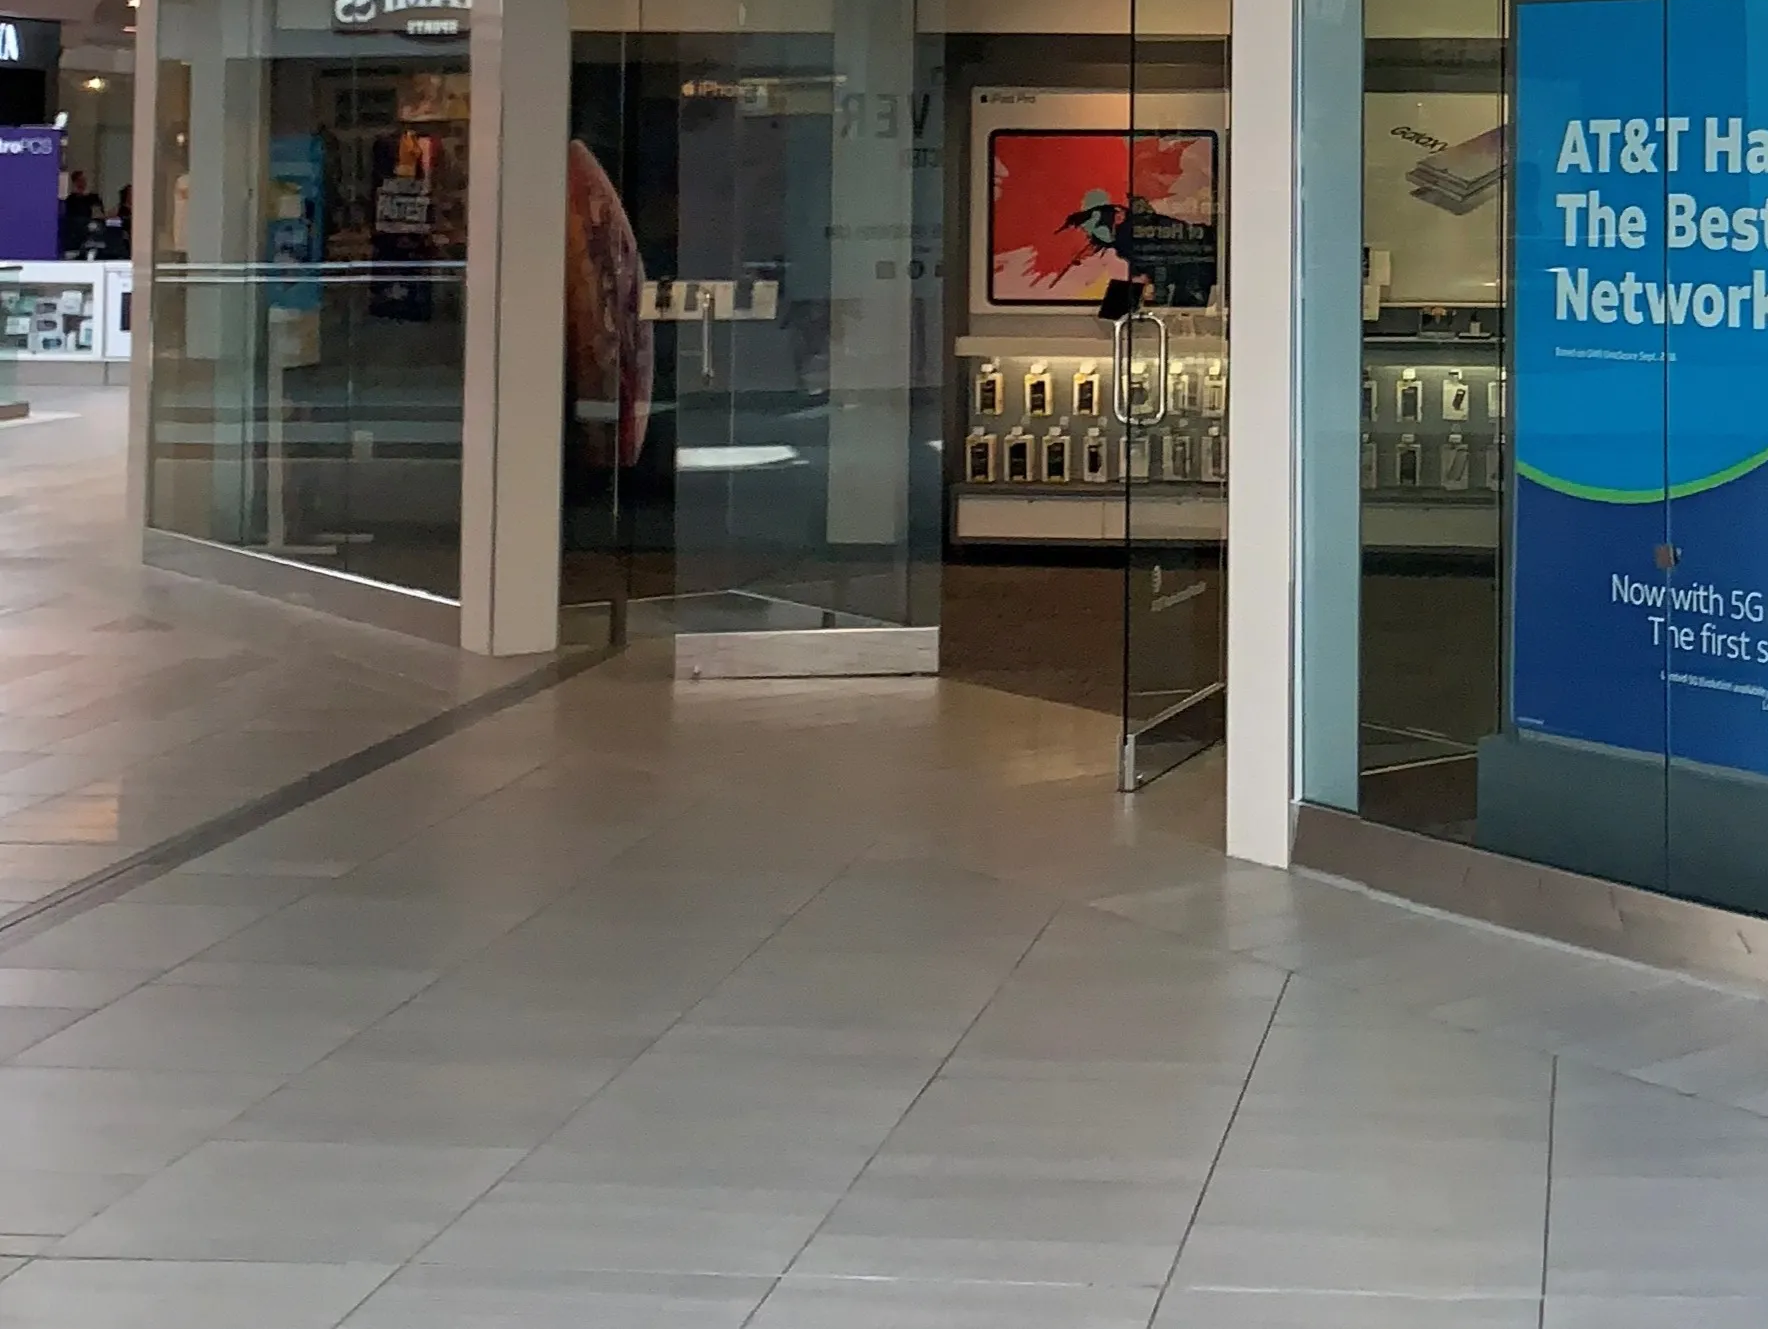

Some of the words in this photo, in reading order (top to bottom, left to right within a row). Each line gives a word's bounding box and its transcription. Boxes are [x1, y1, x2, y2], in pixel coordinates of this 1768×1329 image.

[1390, 126, 1449, 153] Galaxy
[1556, 117, 1688, 174] AT&T
[1556, 190, 1646, 249] The
[1611, 574, 1666, 608] Now
[1673, 583, 1723, 616] with
[1731, 591, 1763, 622] 5G
[1648, 616, 1694, 650] The
[1700, 623, 1750, 660] first
